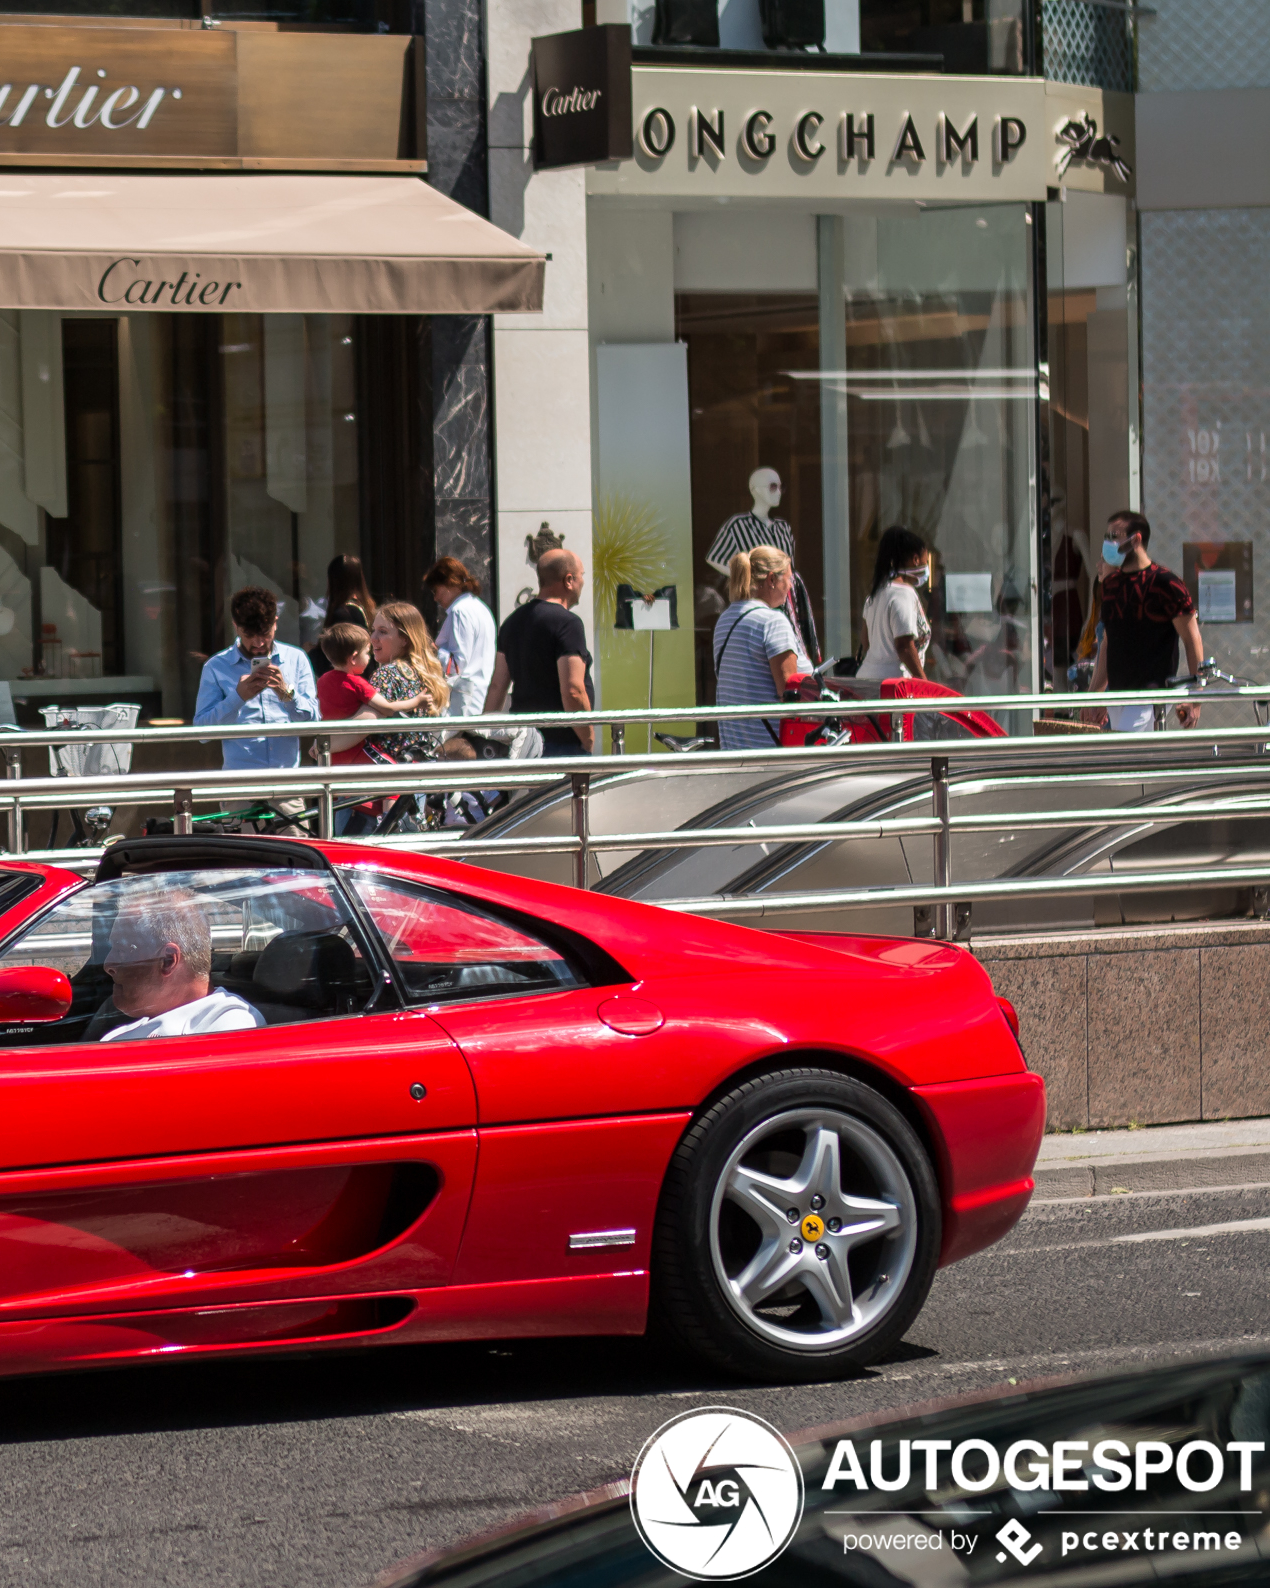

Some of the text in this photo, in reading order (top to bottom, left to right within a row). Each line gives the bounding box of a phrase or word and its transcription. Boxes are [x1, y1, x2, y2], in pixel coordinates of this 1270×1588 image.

[542, 86, 602, 118] Cartier
[639, 106, 1027, 162] ONGCHAMP
[98, 258, 242, 306] Cartier
